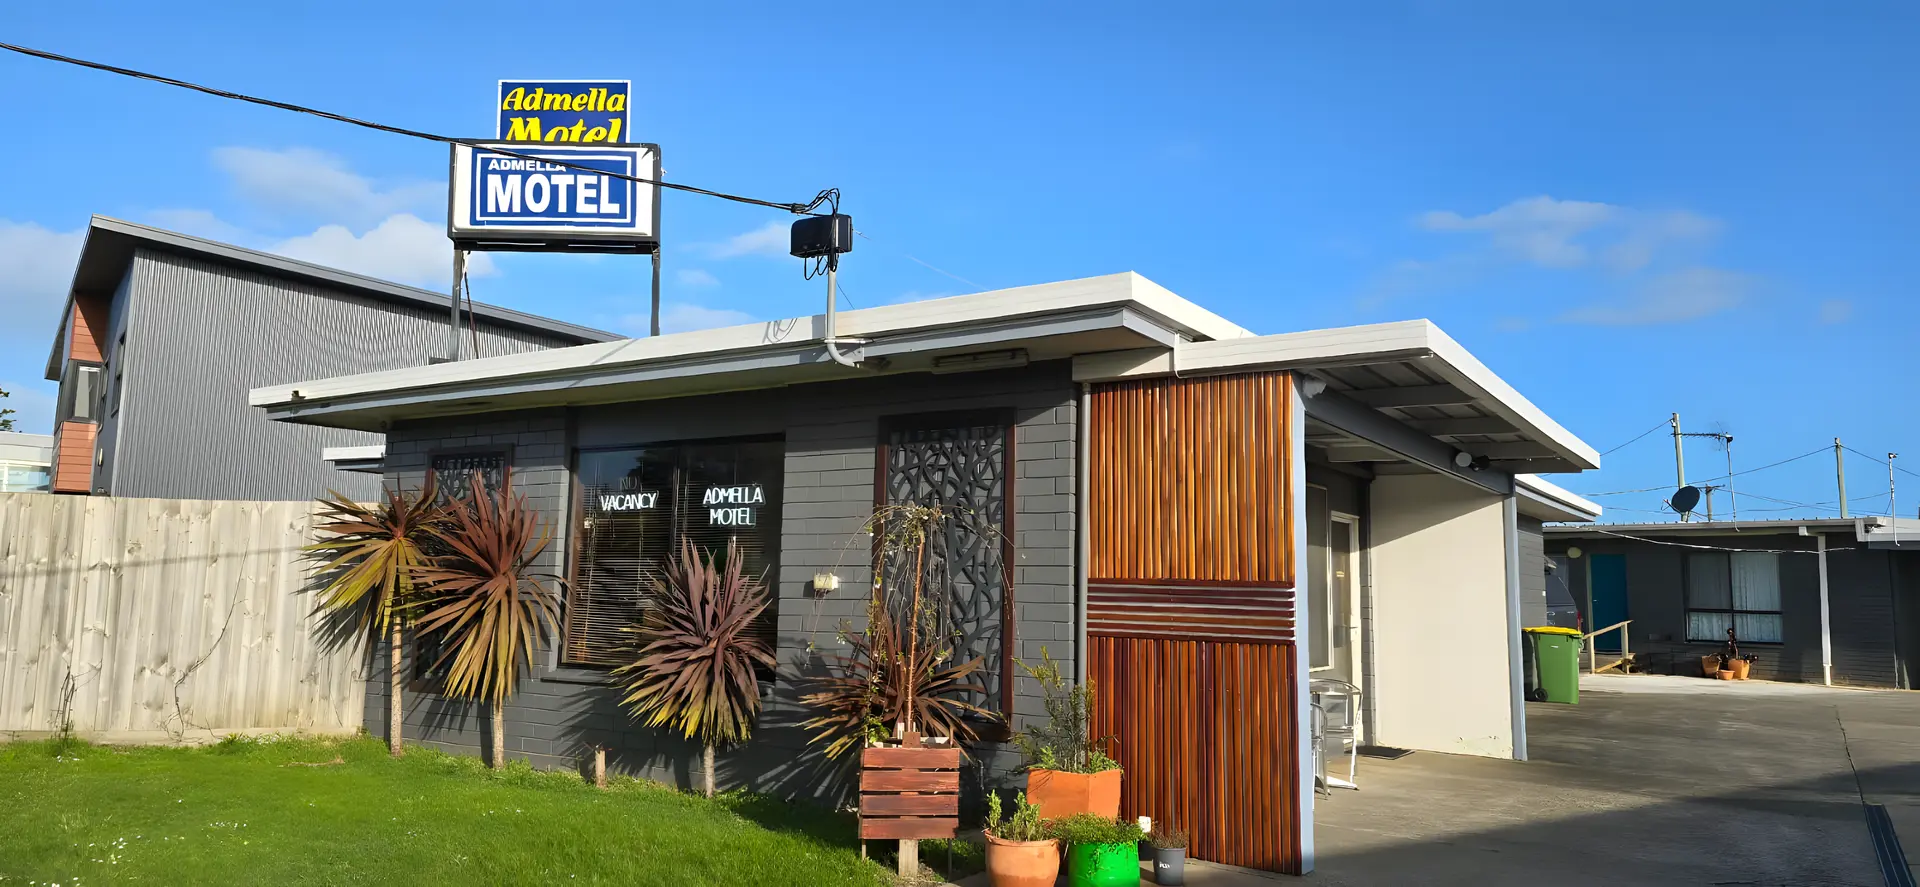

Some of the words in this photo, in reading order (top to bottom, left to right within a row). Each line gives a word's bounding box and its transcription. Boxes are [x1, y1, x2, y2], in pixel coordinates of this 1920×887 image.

[502, 88, 625, 111] Admella
[506, 117, 621, 143] Motel
[487, 173, 620, 214] MOTEL
[600, 492, 657, 511] VACANCY
[703, 486, 764, 504] ADMELLA
[709, 507, 756, 526] MOTEL
